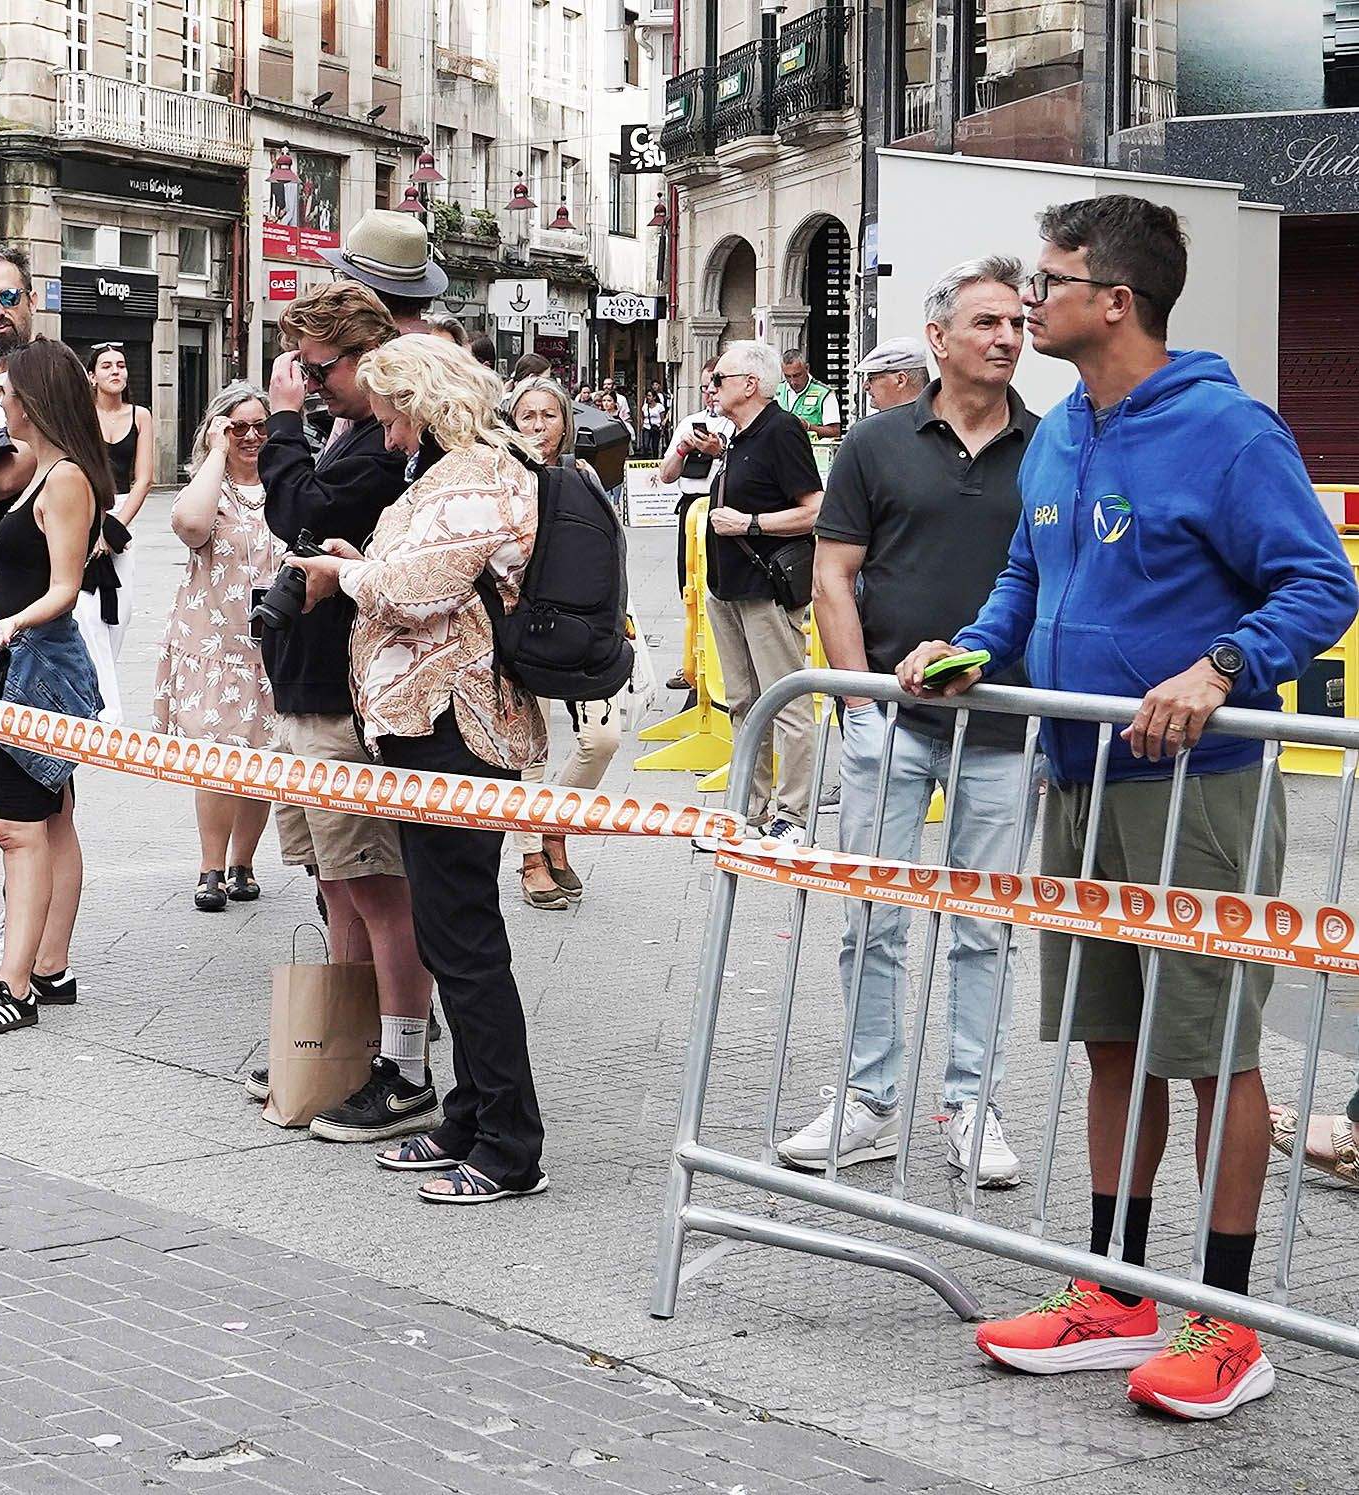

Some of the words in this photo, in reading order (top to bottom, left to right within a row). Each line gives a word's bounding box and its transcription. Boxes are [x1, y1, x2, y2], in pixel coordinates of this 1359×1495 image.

[98, 277, 131, 301] Orange
[270, 279, 296, 289] GAES
[608, 298, 645, 308] MODA
[602, 307, 651, 318] CENTER
[628, 461, 662, 469] NATURCA
[1034, 503, 1059, 527] BRA
[294, 1040, 323, 1049] WITH
